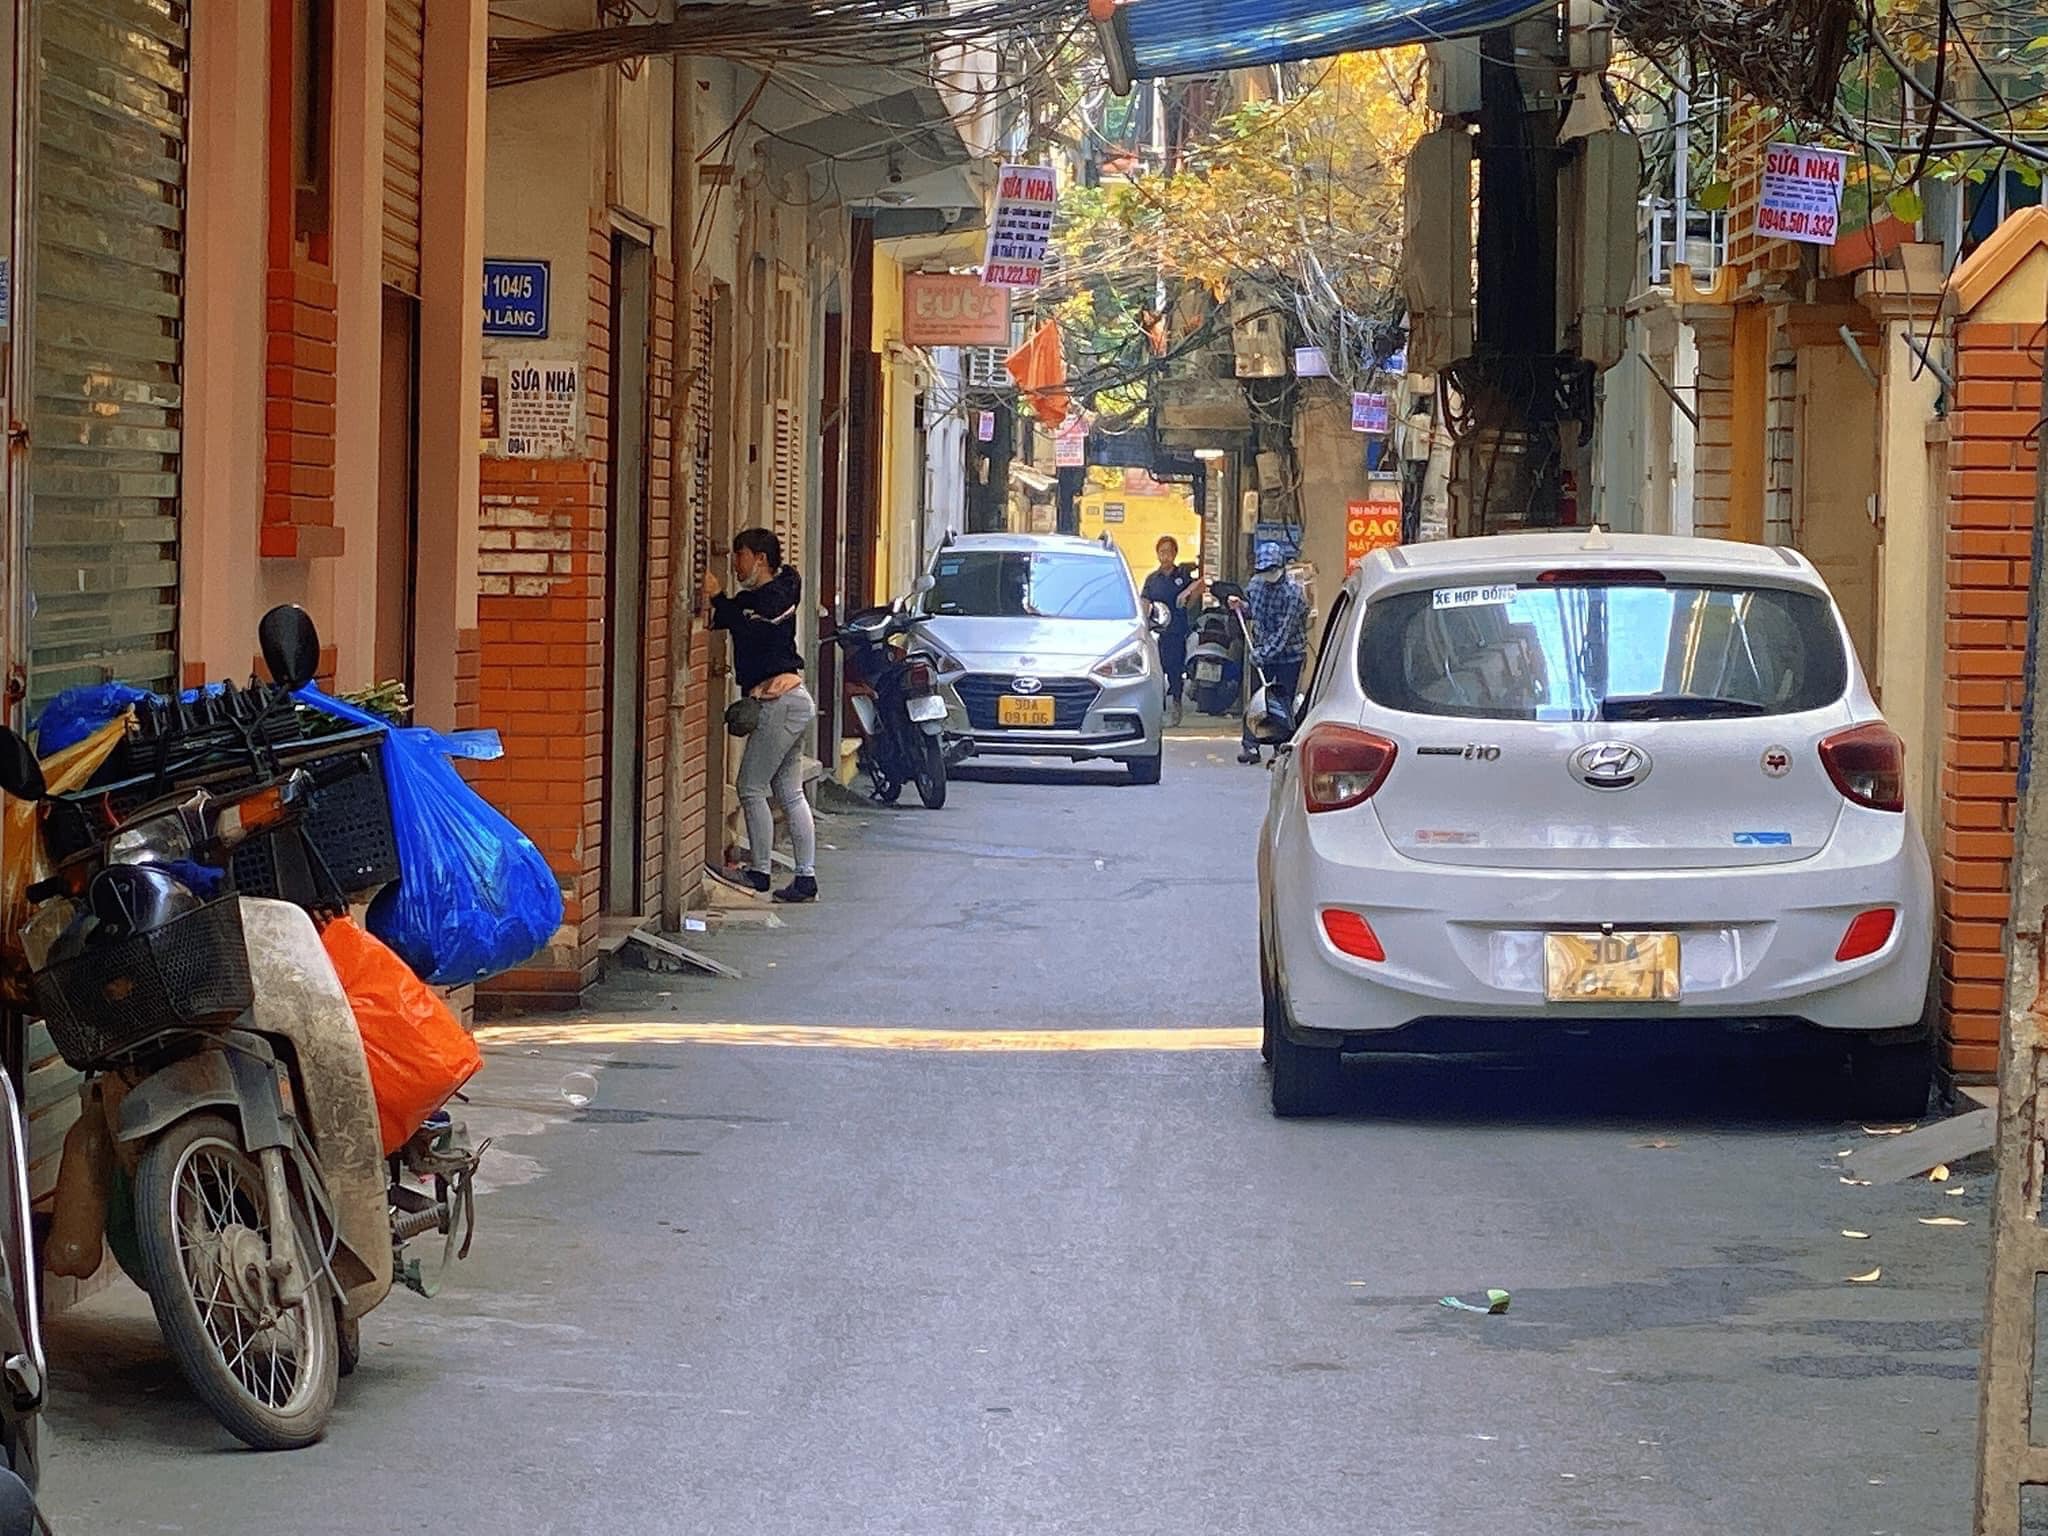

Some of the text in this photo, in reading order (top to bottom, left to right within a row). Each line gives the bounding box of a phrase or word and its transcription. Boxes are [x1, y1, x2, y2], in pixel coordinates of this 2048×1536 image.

[1758, 208, 1834, 237] 0946.501.332
[493, 274, 532, 298] 104/5
[495, 305, 536, 326] LÃNG
[1435, 590, 1451, 605] XE
[1464, 742, 1501, 761] i10
